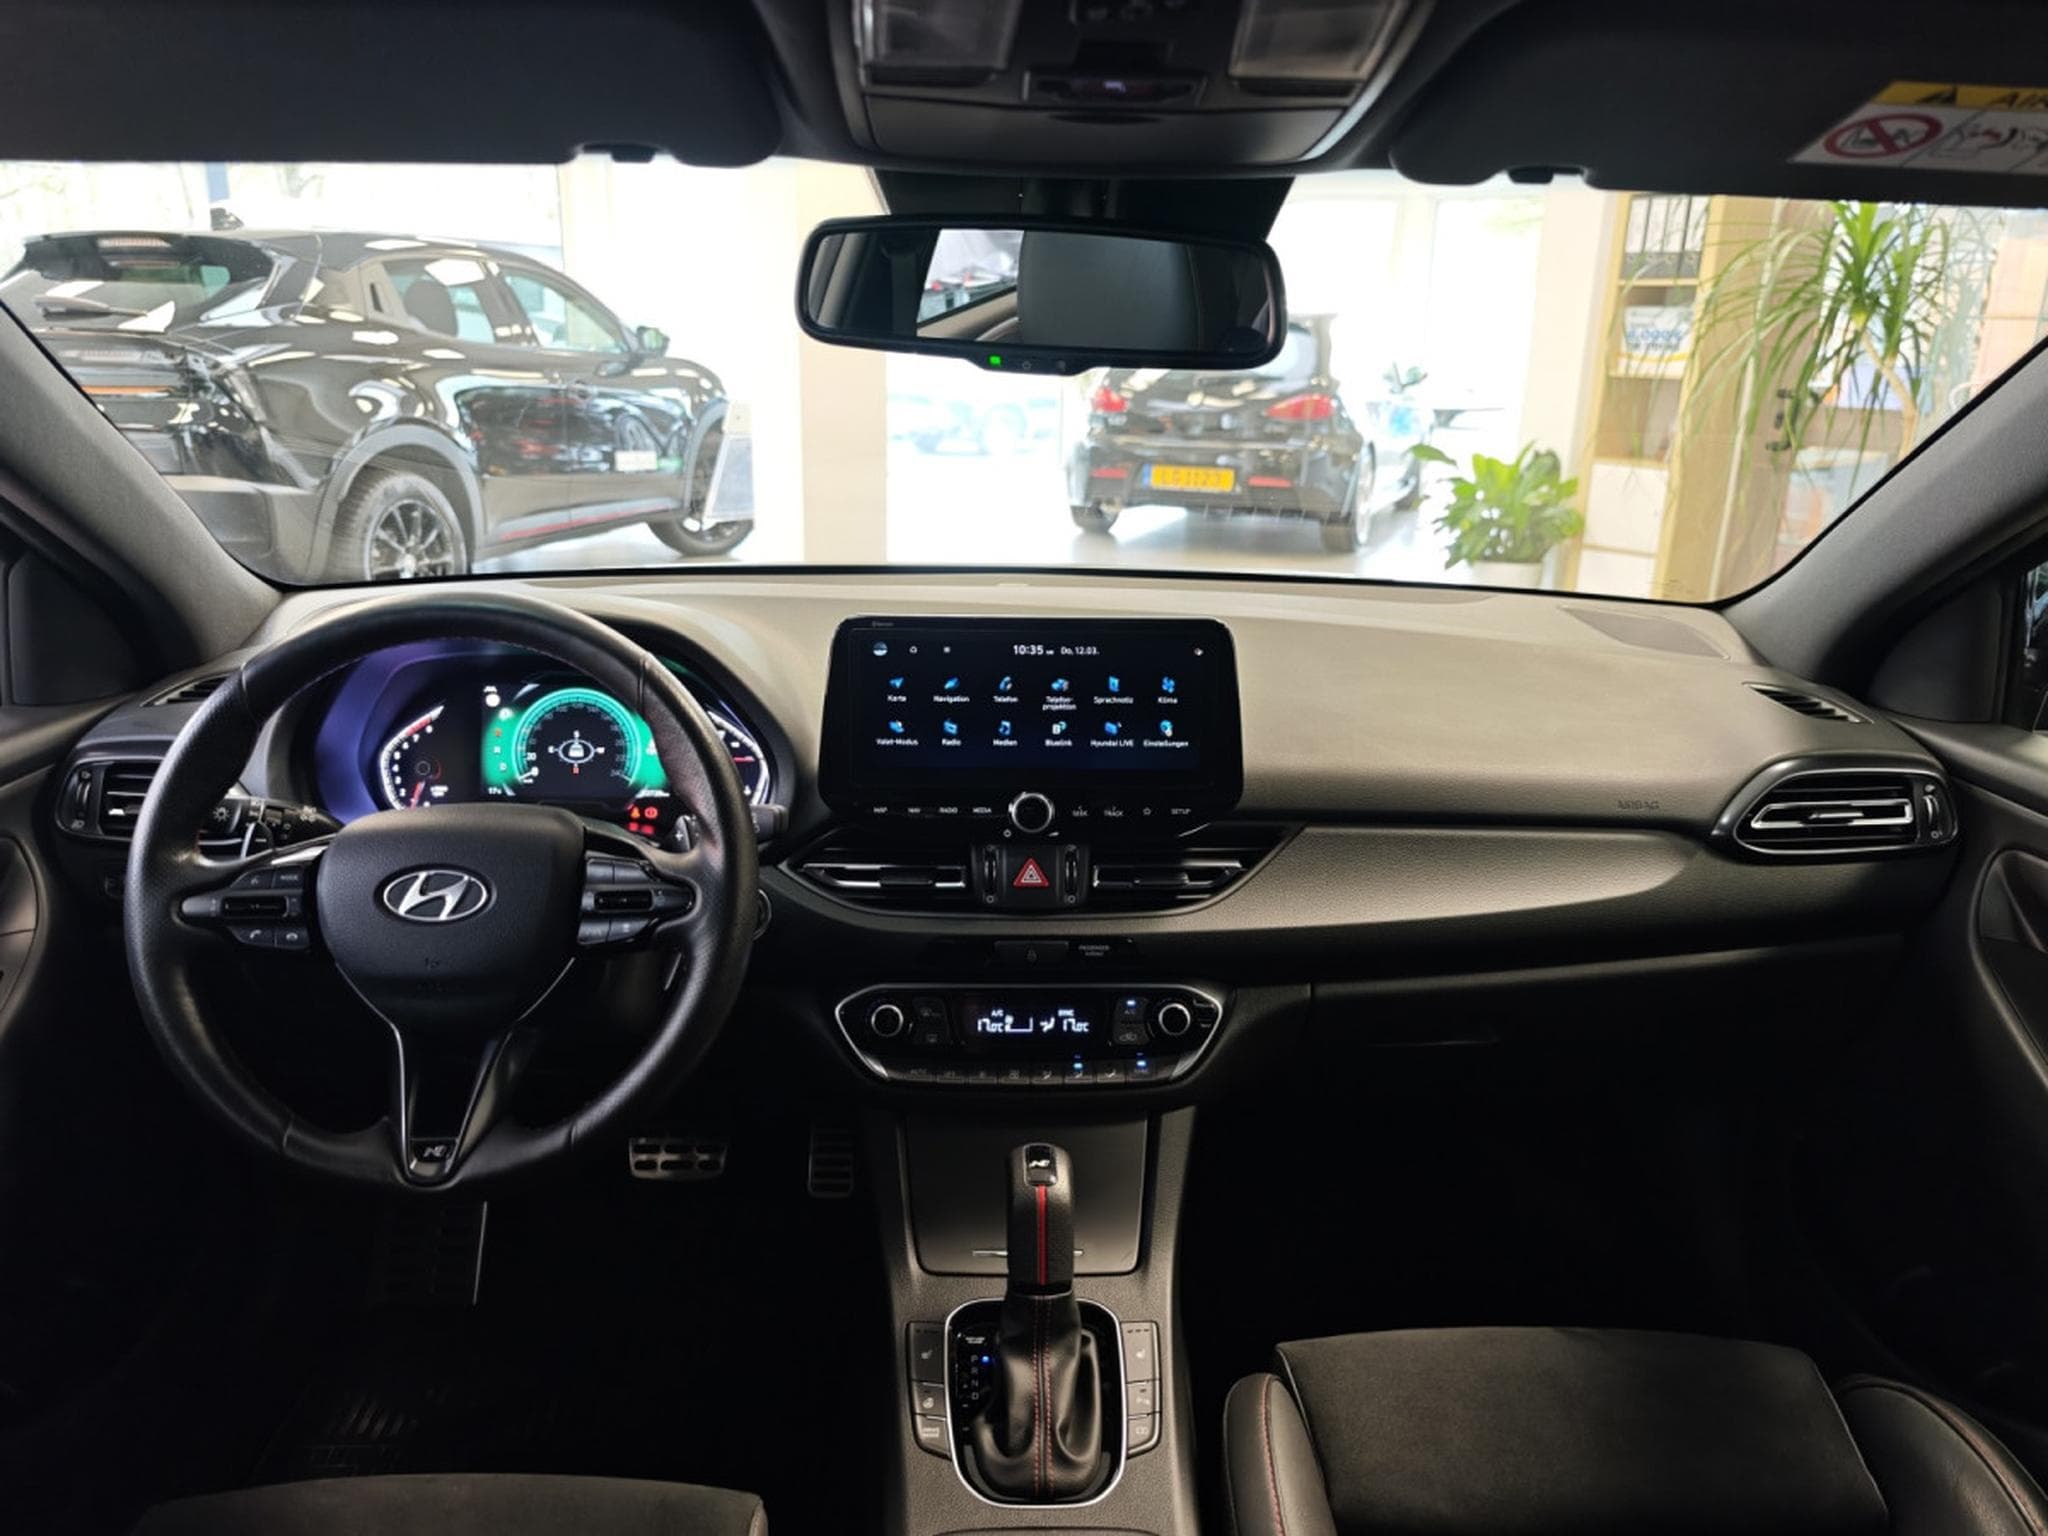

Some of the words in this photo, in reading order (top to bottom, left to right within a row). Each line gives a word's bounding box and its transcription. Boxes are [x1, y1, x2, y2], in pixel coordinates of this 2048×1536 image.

[1013, 644, 1044, 655] 10:35
[933, 695, 970, 704] Navigation
[1093, 696, 1134, 705] Sprachnotiz
[1157, 696, 1178, 704] Klima
[1042, 703, 1077, 711] projektion
[1090, 739, 1118, 747] Hyundai
[1118, 739, 1134, 747] LIVE
[1143, 740, 1189, 748] Einstellungen
[971, 1392, 979, 1400] D
